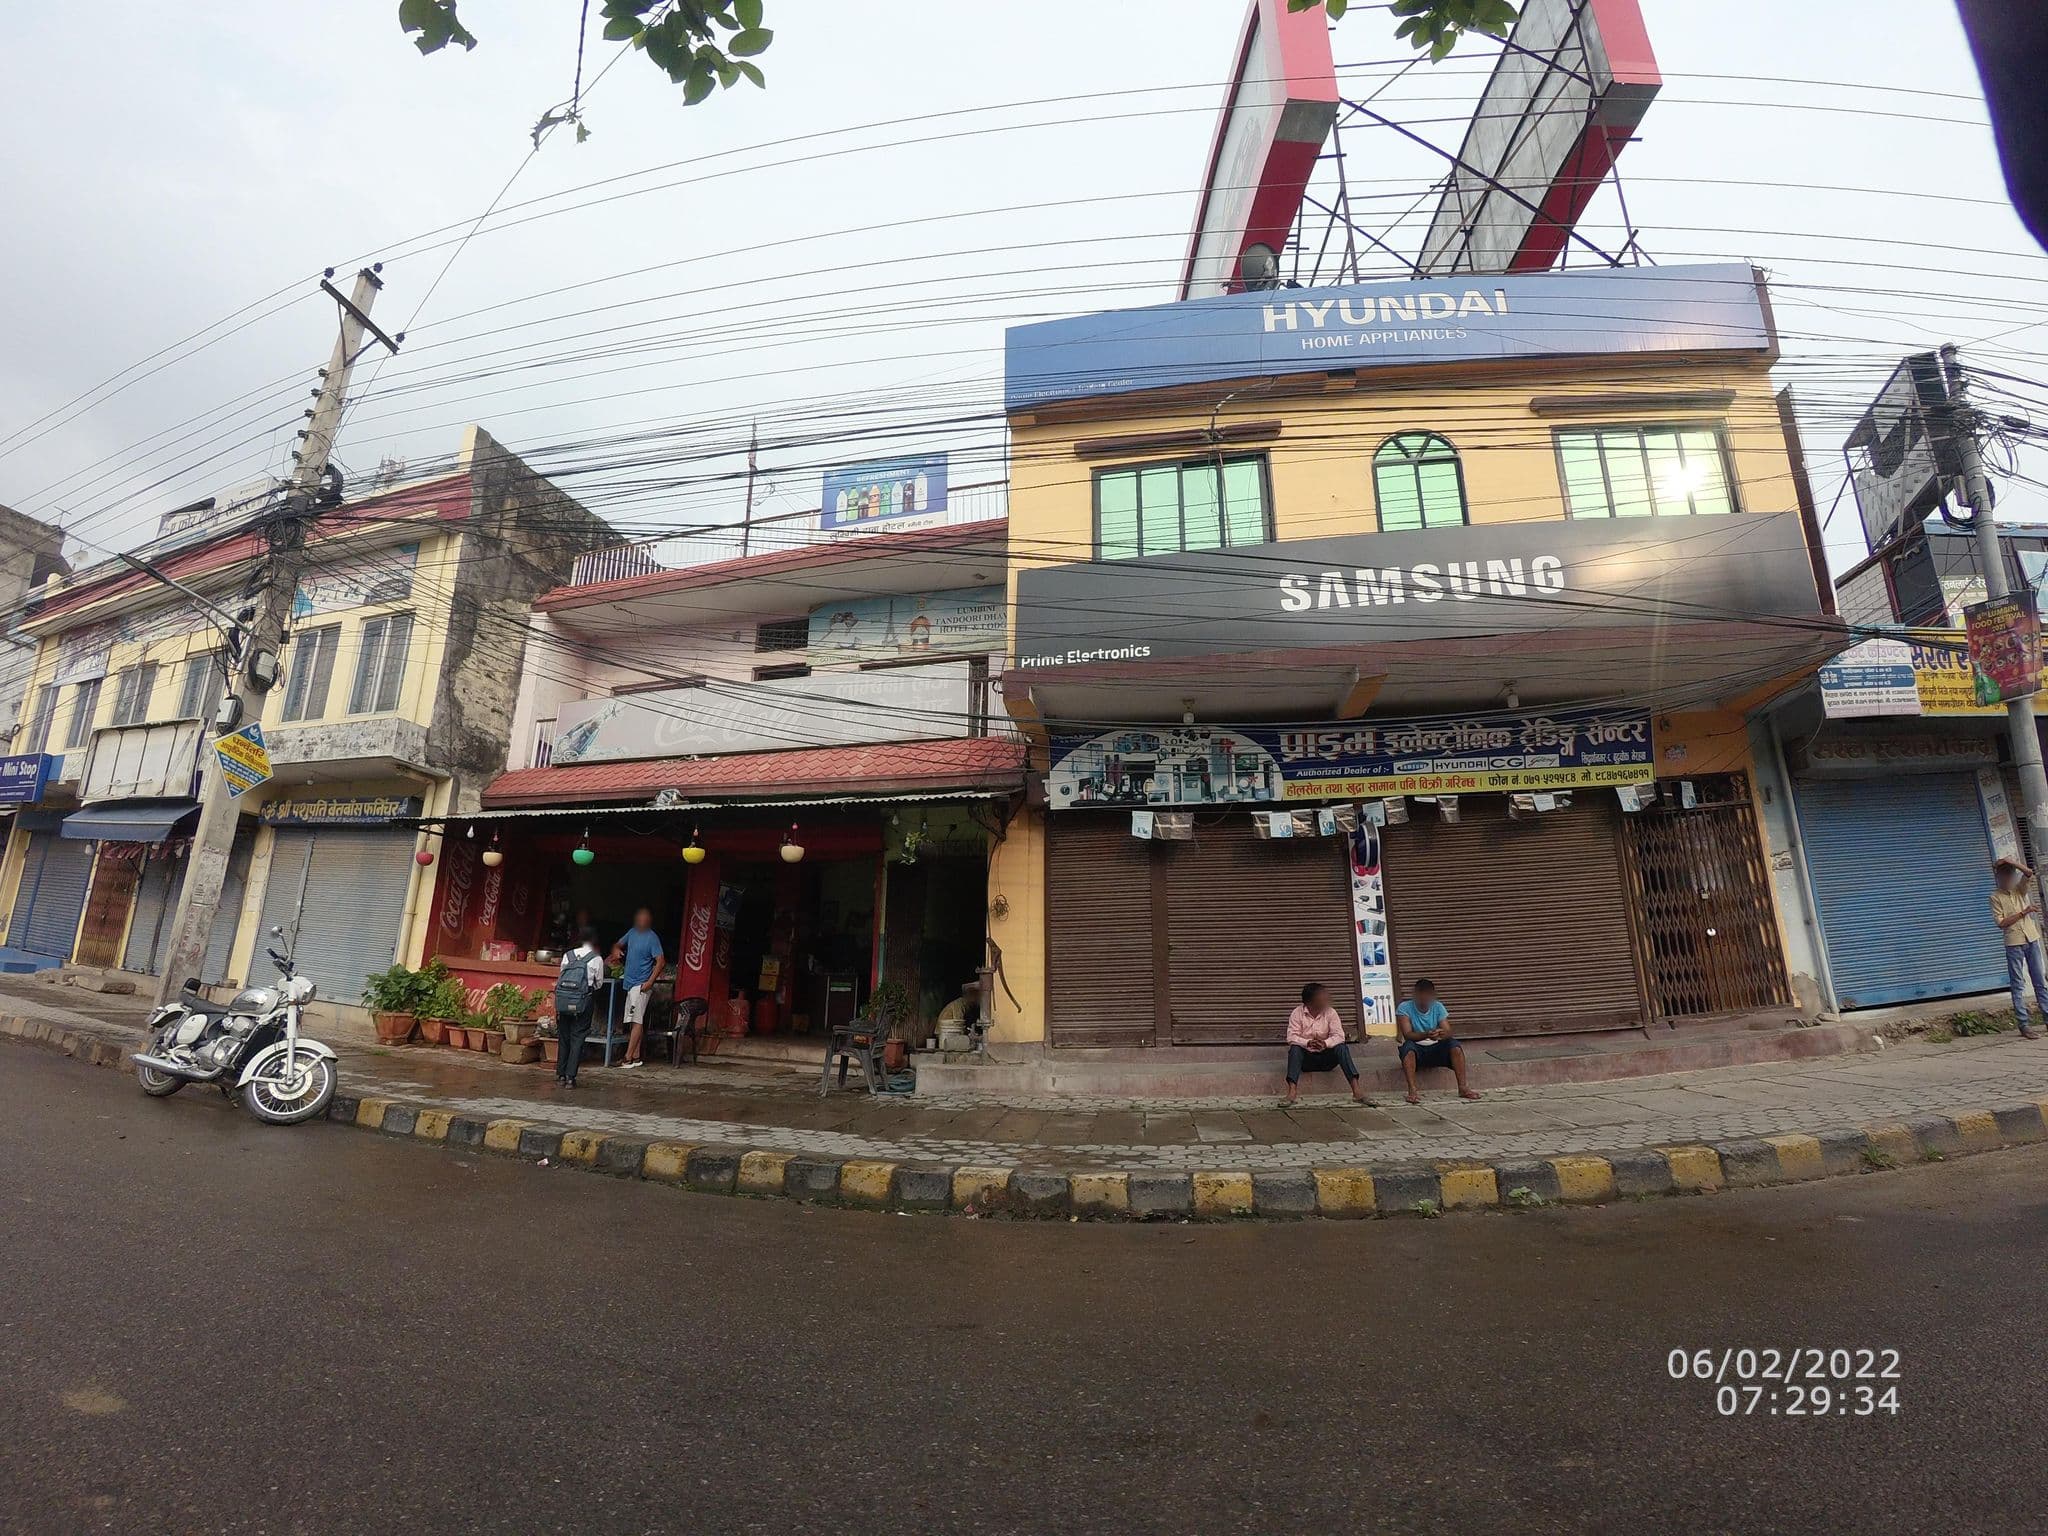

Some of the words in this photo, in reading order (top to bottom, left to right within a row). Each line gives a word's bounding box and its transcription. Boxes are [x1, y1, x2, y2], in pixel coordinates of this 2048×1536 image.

[1263, 289, 1508, 332] HYUNDAI
[1301, 334, 1354, 350] HOME
[1359, 326, 1468, 345] APPLIANCES
[1279, 555, 1565, 612] SAMSUNG
[935, 614, 981, 625] TANDOORI
[1021, 653, 1064, 668] Prime
[1067, 644, 1151, 664] Electronics
[1584, 716, 1648, 746] सेन्टर
[2, 761, 19, 777] Mini
[19, 760, 37, 779] Stop
[1296, 767, 1342, 777] Authorized
[1344, 766, 1371, 775] Dealer
[1372, 765, 1382, 773] of
[1435, 760, 1487, 770] HYUNDAI
[1490, 757, 1524, 769] CG
[1286, 782, 1322, 797] होलसेल
[1325, 782, 1343, 794] तथा
[1367, 780, 1396, 793] सामान
[1399, 777, 1417, 791] पनि
[1488, 774, 1509, 787] फोन
[278, 799, 292, 820] श्री
[292, 799, 328, 821] पशुपति
